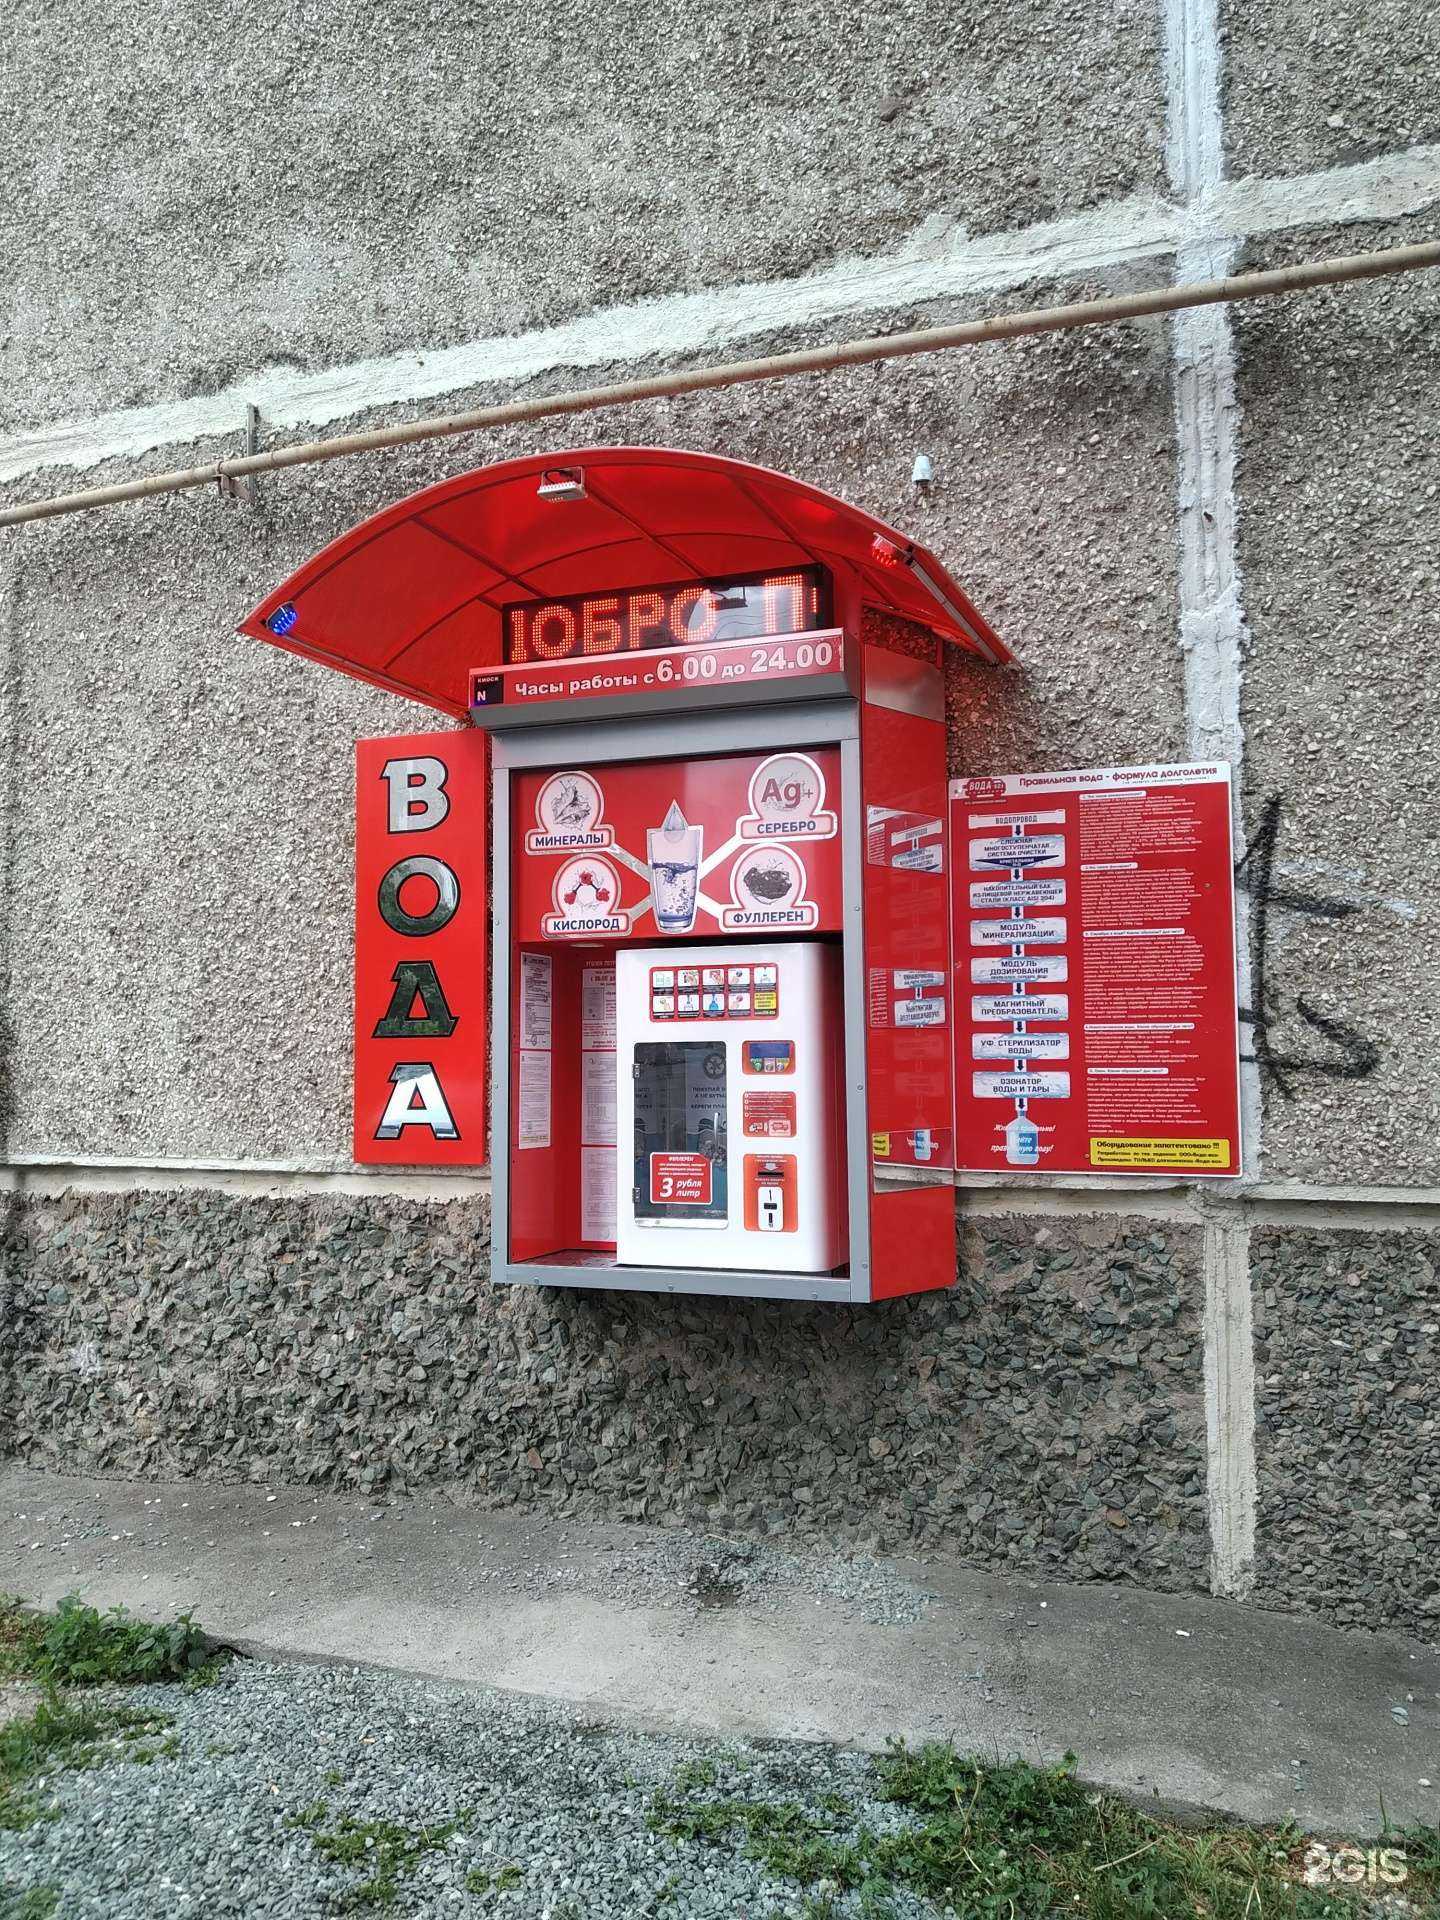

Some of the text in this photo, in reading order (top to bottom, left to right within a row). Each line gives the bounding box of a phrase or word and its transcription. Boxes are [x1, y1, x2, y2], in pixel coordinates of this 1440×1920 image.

[763, 574, 817, 634] П
[515, 642, 833, 697] Часы работы с 6.00 до 24.00
[1019, 775, 1077, 787] Правильная
[1079, 774, 1104, 783] вода
[1112, 771, 1158, 782] формула
[1160, 767, 1218, 779] долголетия
[995, 815, 1038, 825] ВОДОПРОВОД
[756, 820, 817, 834] СЕРЕБРО
[535, 833, 604, 847] МИНЕРАЛЫ
[984, 843, 1050, 852] МНОГОСТУПЕНЧАТАЯ
[983, 884, 1039, 892] НАКОПИТЕЛЬНЫЙ
[733, 910, 804, 924] ФУЛЛЕРЕН
[553, 918, 620, 932] КИСЛОРОД
[1000, 923, 1037, 932] МОДУЛЬ
[982, 930, 1055, 940] МИНЕРАЛИЗАЦИИ
[371, 756, 462, 1141] ВОДА
[989, 967, 1049, 976] ДОЗИРОВАНИЯ
[993, 1000, 1045, 1008] МАГНИТНЫЙ
[981, 1007, 1059, 1016] ПРЕОБРАЗОВАТЕЛЬ
[998, 1039, 1061, 1047] СТЕРИЛИЗАТОР
[1008, 1047, 1033, 1055] ВОДЫ
[993, 1085, 1018, 1093] ВОДЫ
[1027, 1085, 1050, 1093] ТАРЫ
[1096, 1141, 1152, 1149] Оборудование
[659, 1177, 703, 1198] 3 рубля
[675, 1189, 701, 1199] литр
